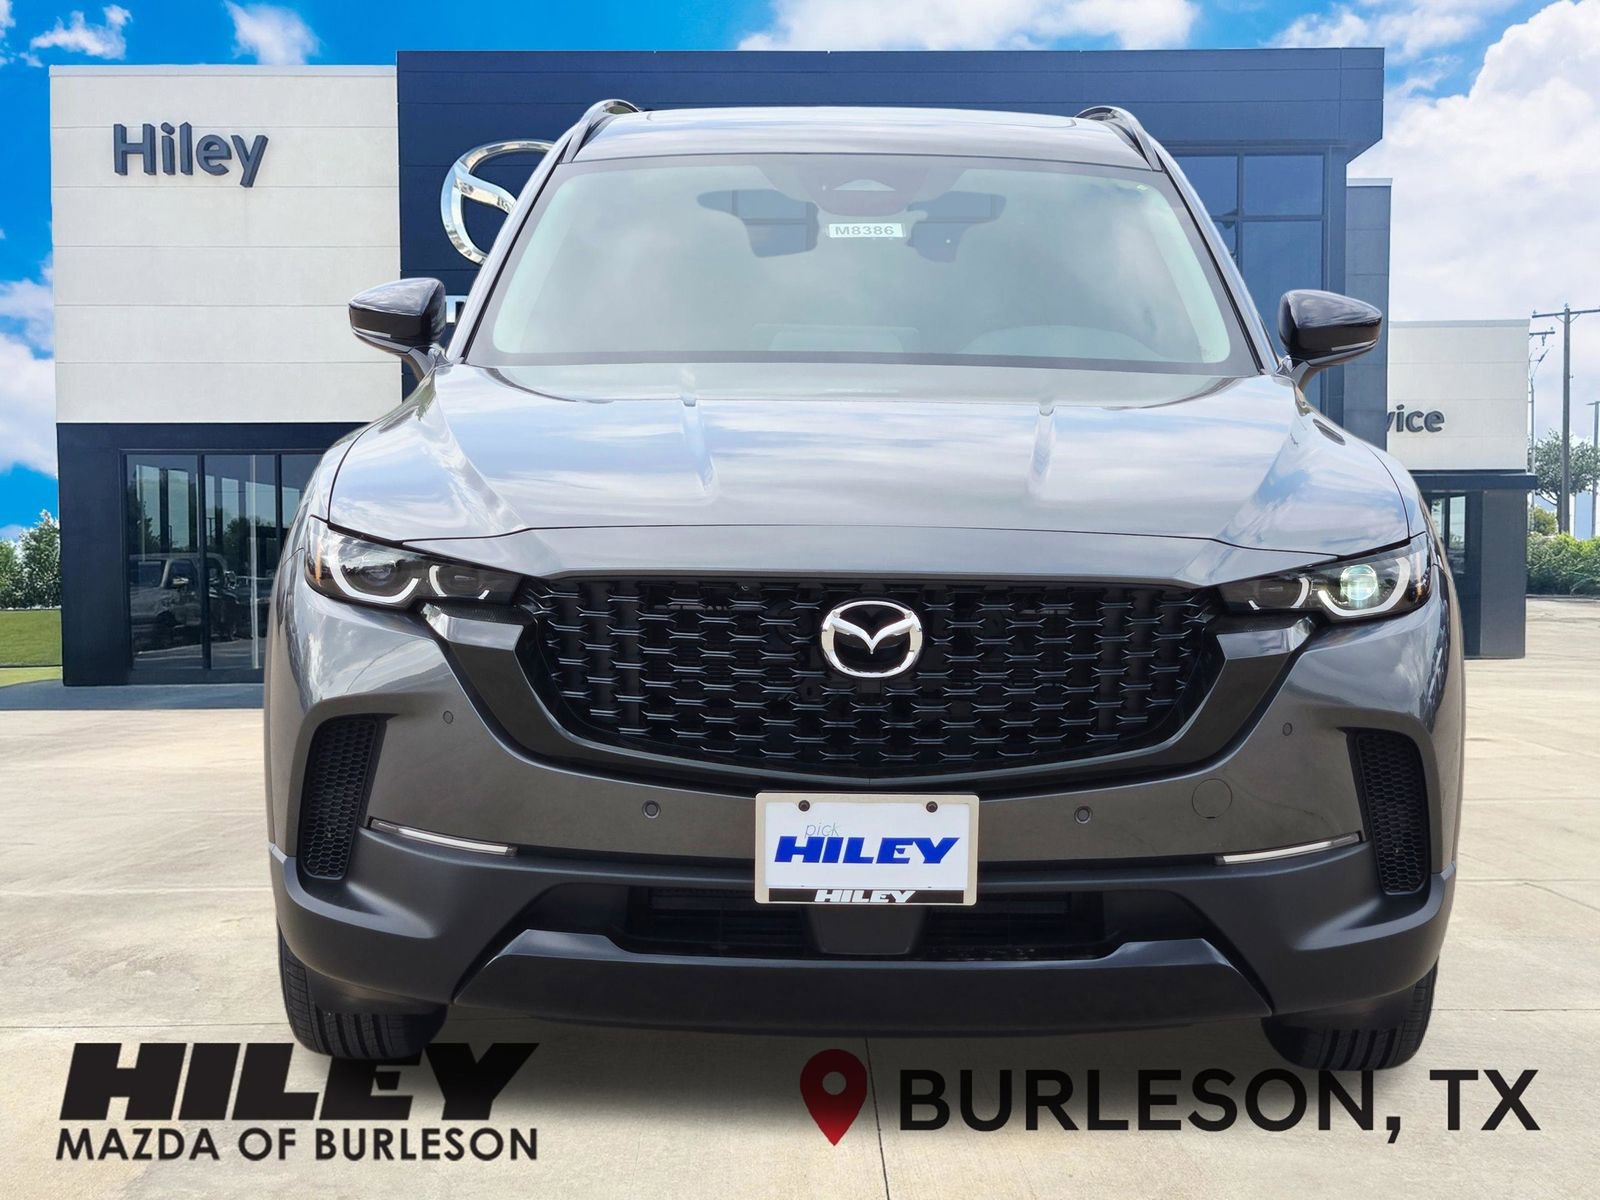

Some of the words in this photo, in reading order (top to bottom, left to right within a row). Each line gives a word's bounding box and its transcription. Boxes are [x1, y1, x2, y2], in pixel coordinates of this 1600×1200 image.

[113, 121, 269, 188] Hiley
[834, 225, 895, 236] M8386
[804, 822, 840, 838] pick
[774, 835, 960, 864] HILEY
[814, 889, 916, 903] HILEY
